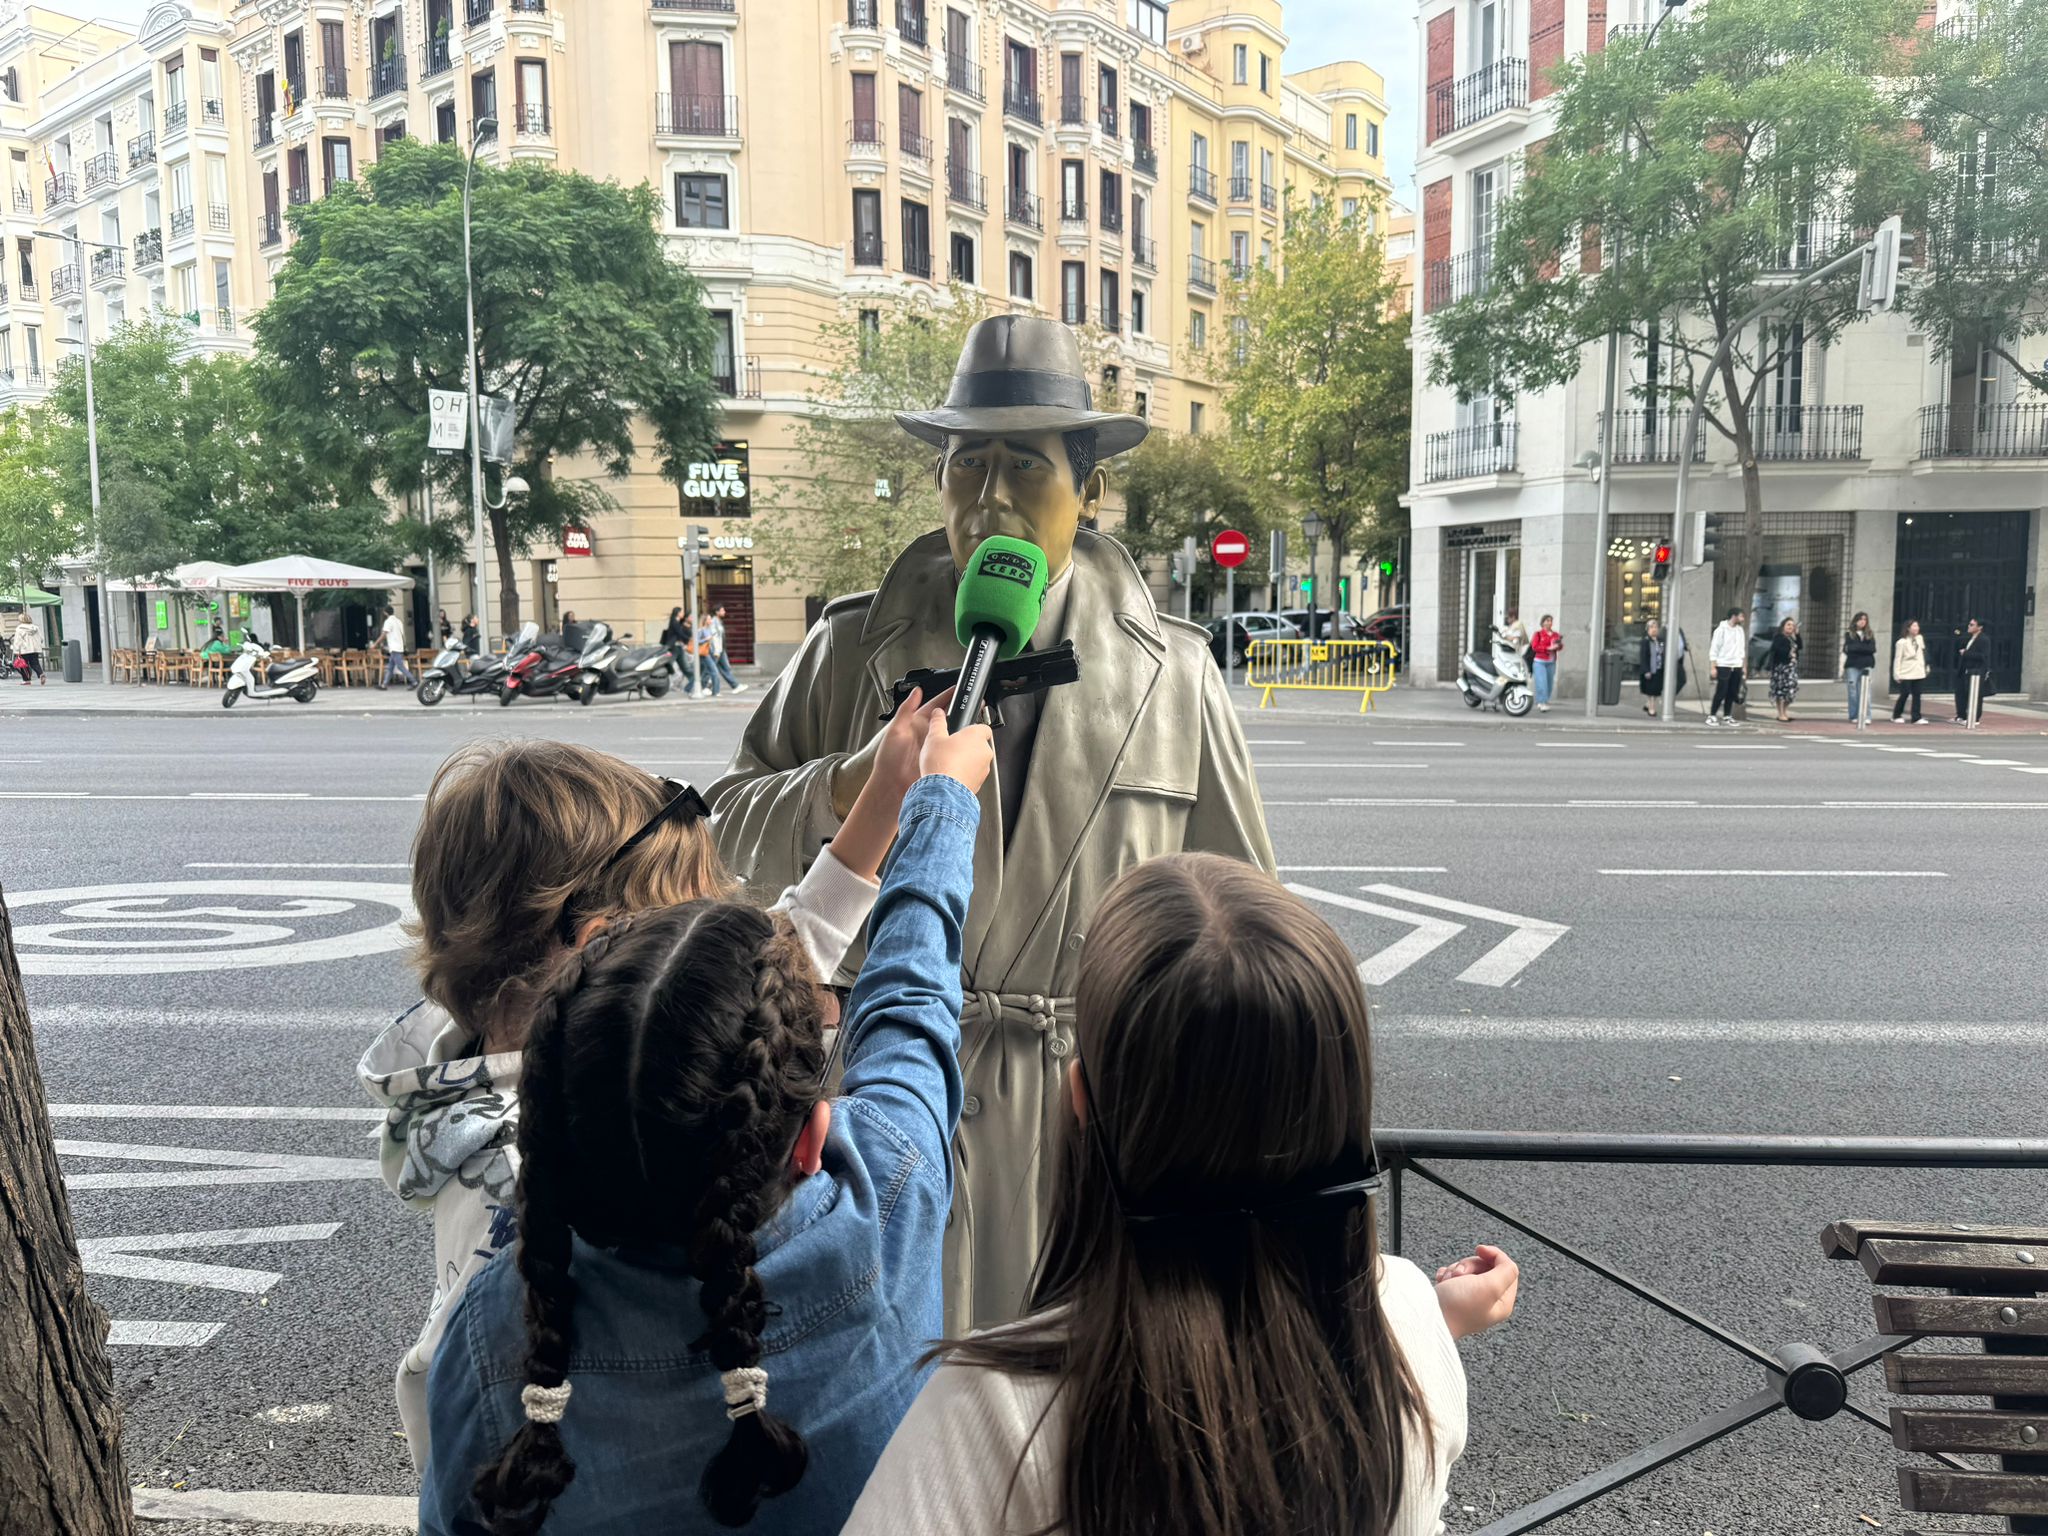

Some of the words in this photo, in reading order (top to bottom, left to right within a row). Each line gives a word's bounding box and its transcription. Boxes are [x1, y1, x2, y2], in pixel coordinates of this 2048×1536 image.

[688, 462, 739, 480] FIVE
[683, 480, 746, 498] GUYS
[714, 536, 753, 549] GUYS
[991, 553, 1029, 568] ONDA
[548, 564, 558, 574] FI
[989, 564, 1026, 579] CERO
[288, 578, 314, 587] FIVE
[318, 578, 349, 587] GUYS
[547, 573, 558, 583] GU
[966, 649, 985, 692] SENNHEISER
